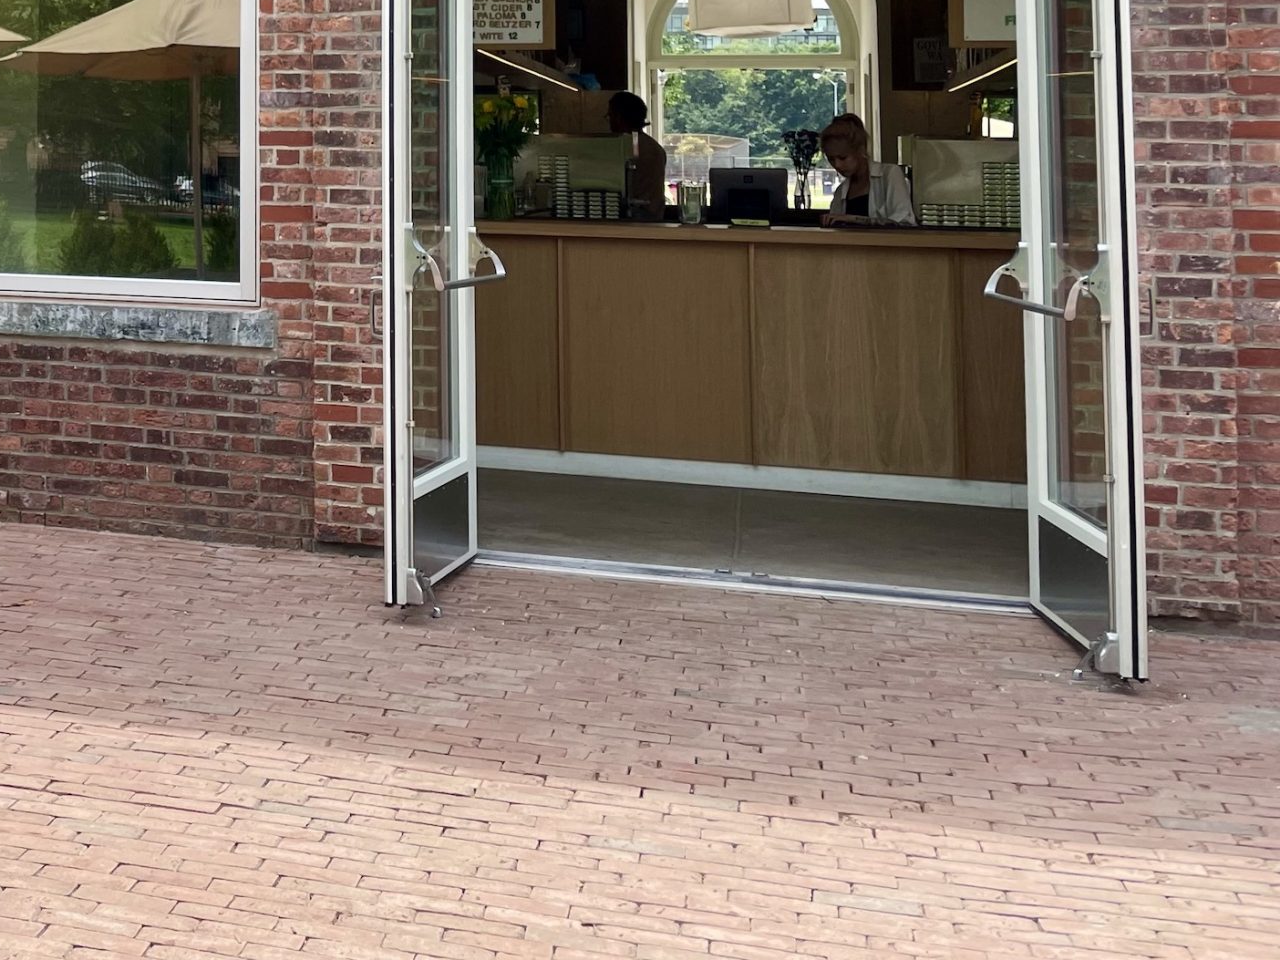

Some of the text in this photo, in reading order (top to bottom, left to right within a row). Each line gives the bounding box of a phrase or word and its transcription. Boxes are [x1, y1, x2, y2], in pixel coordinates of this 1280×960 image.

[491, 4, 522, 12] CIDER
[477, 12, 517, 20] PALOMA
[535, 21, 541, 29] 7
[508, 31, 518, 40] 12
